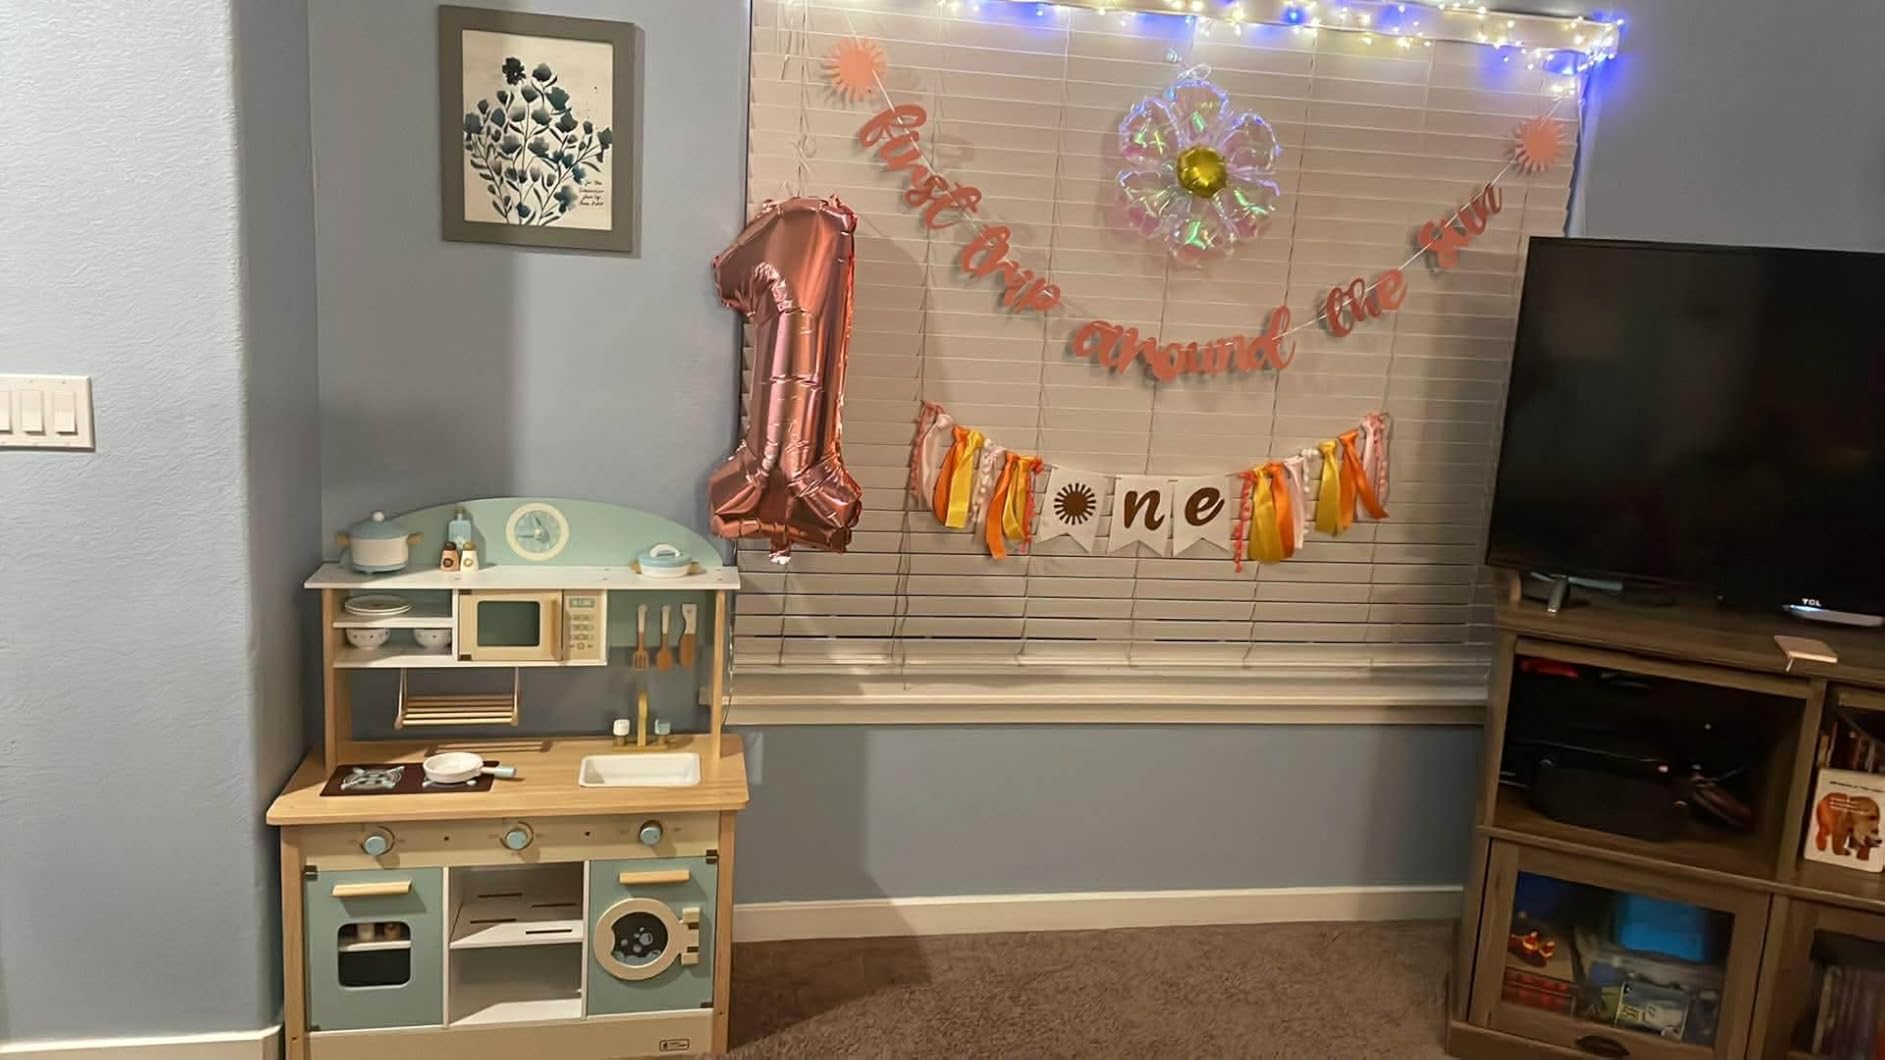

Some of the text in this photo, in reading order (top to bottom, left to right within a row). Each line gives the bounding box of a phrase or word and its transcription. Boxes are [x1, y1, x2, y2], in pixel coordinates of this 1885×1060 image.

[859, 104, 1502, 383] first trip around the sun
[1802, 598, 1822, 607] TCL
